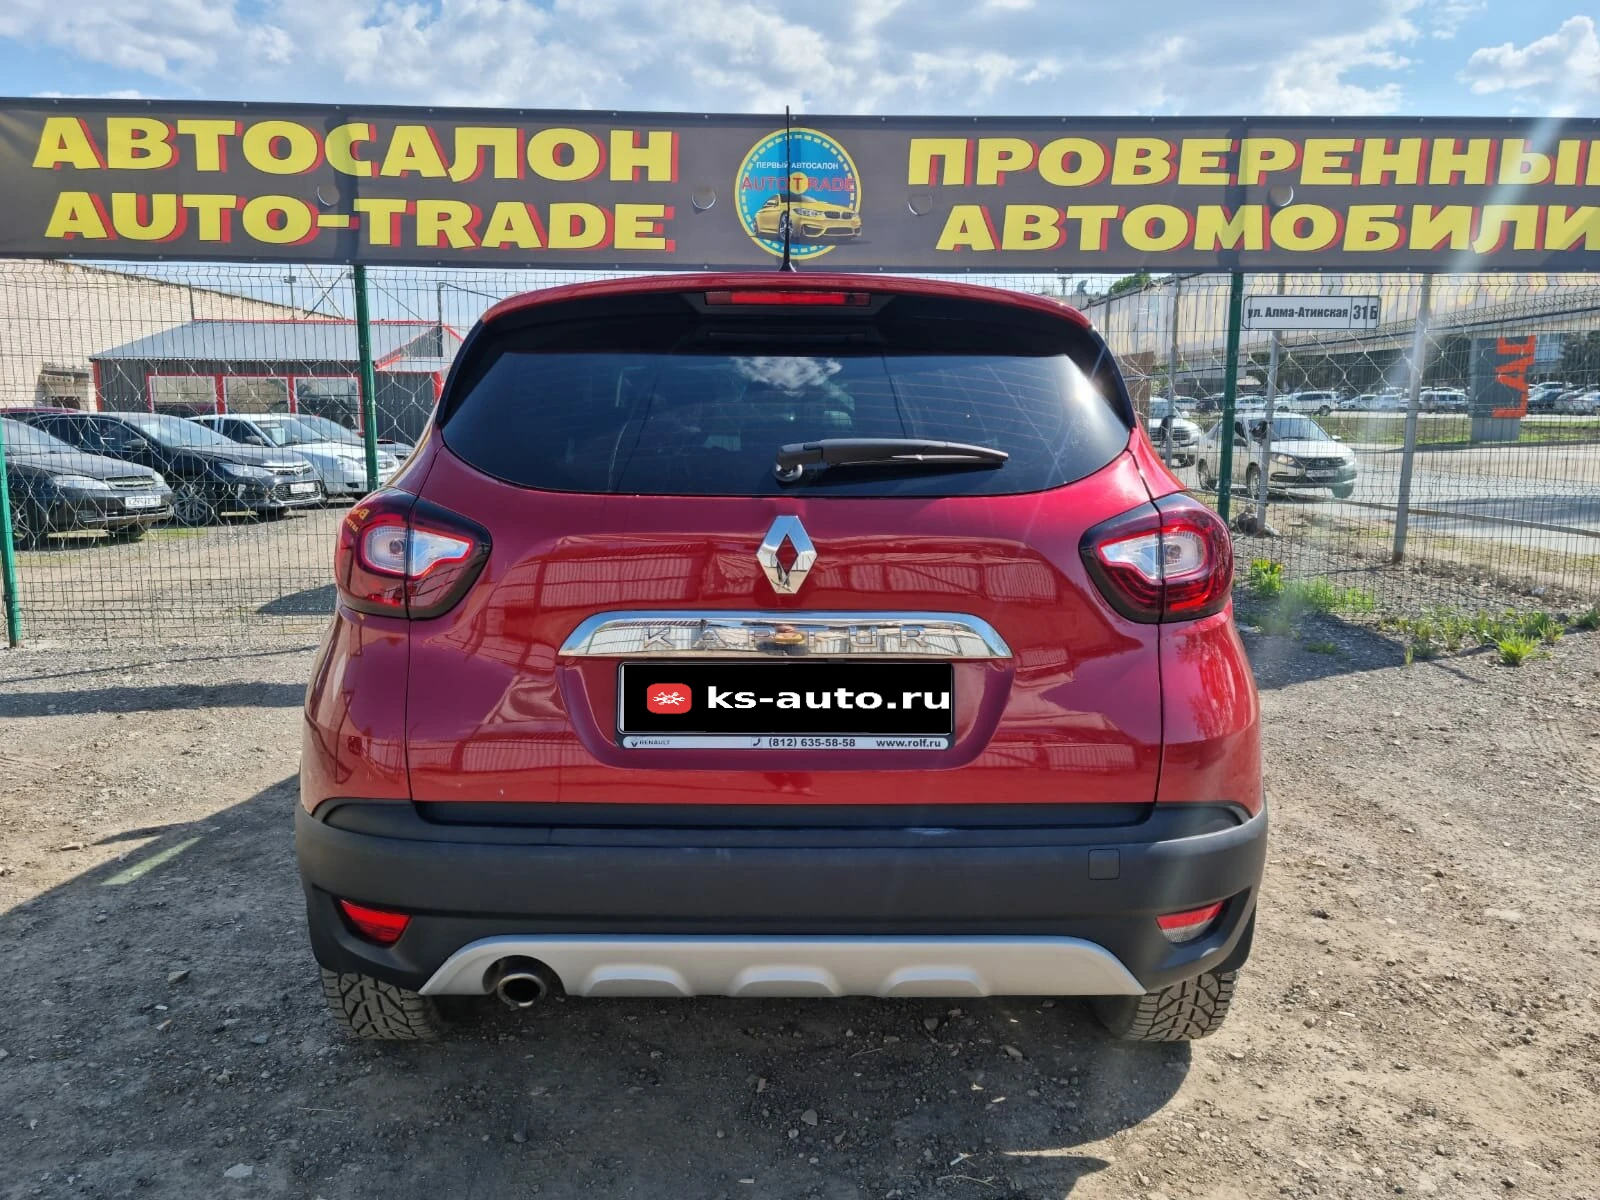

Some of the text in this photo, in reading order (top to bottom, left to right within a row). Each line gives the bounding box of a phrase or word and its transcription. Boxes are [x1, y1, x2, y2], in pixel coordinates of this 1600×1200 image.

[32, 117, 678, 183] АВТОСАЛОН
[756, 160, 839, 170] ПЕРВЫЙ АВТОСАЛОН
[44, 191, 675, 252] AUTO-TRADE
[935, 203, 1600, 255] АВТОМОБИЛИ
[1247, 307, 1263, 319] ул.
[1265, 306, 1349, 318] Алма-Атинская
[768, 737, 856, 748] (812) 635-58-58
[876, 738, 941, 748] www.rolf.ru
